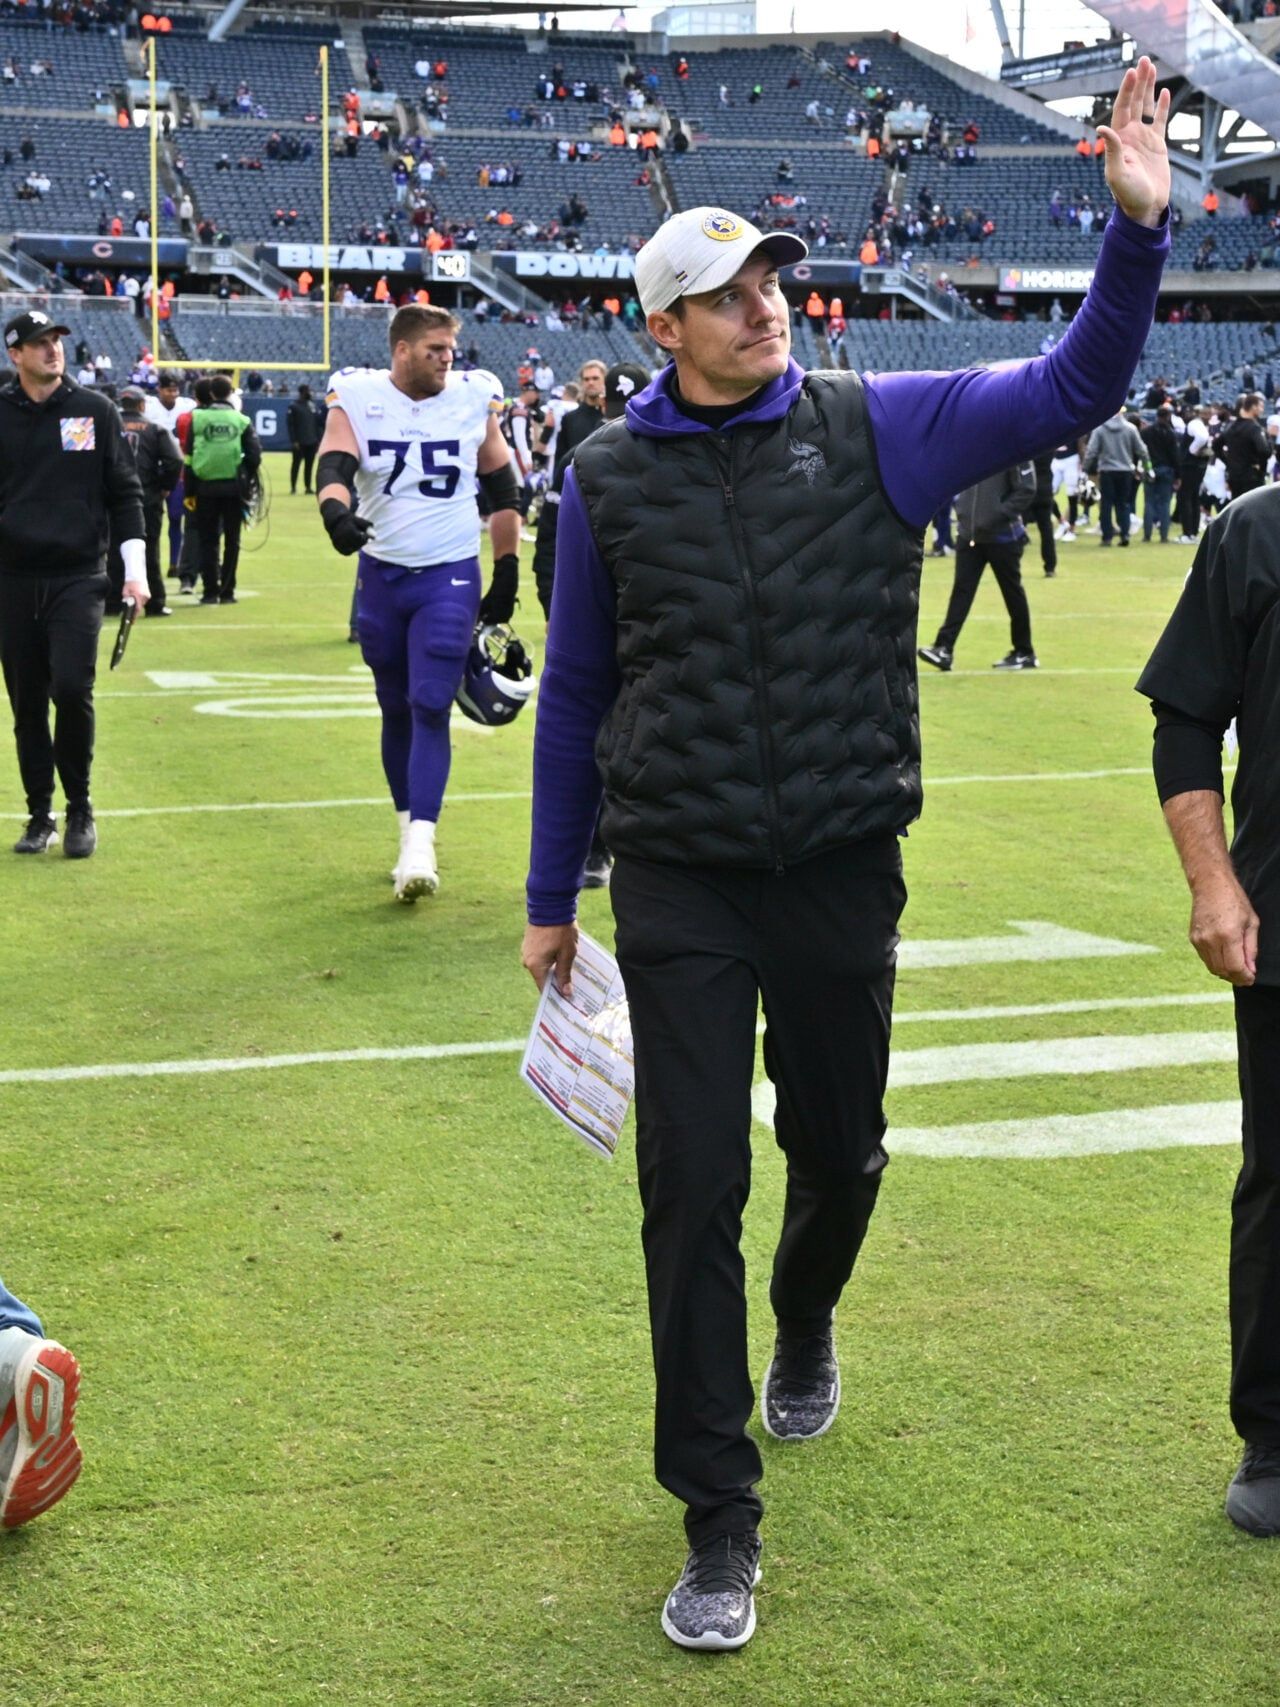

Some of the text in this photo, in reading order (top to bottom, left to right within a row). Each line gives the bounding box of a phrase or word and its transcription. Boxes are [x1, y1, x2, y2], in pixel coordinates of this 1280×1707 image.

[277, 243, 406, 272] BEAR
[437, 255, 466, 278] 40
[255, 410, 277, 436] G
[367, 439, 461, 499] 75
